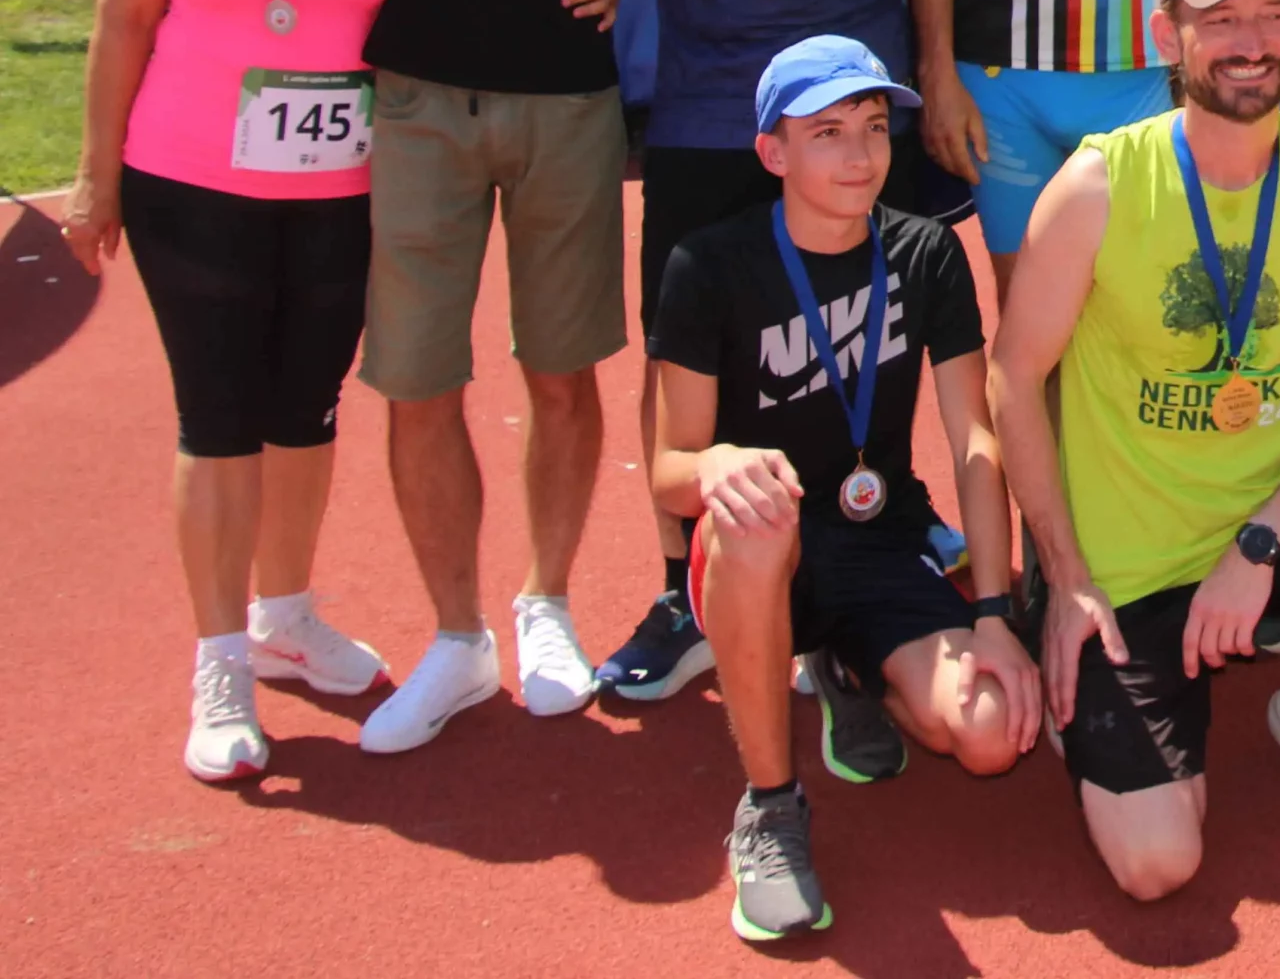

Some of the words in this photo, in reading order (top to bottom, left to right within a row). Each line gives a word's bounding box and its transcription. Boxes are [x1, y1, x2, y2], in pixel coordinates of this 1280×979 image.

[268, 101, 353, 142] 145
[757, 271, 909, 401] NIKE
[1138, 401, 1222, 432] CENK
